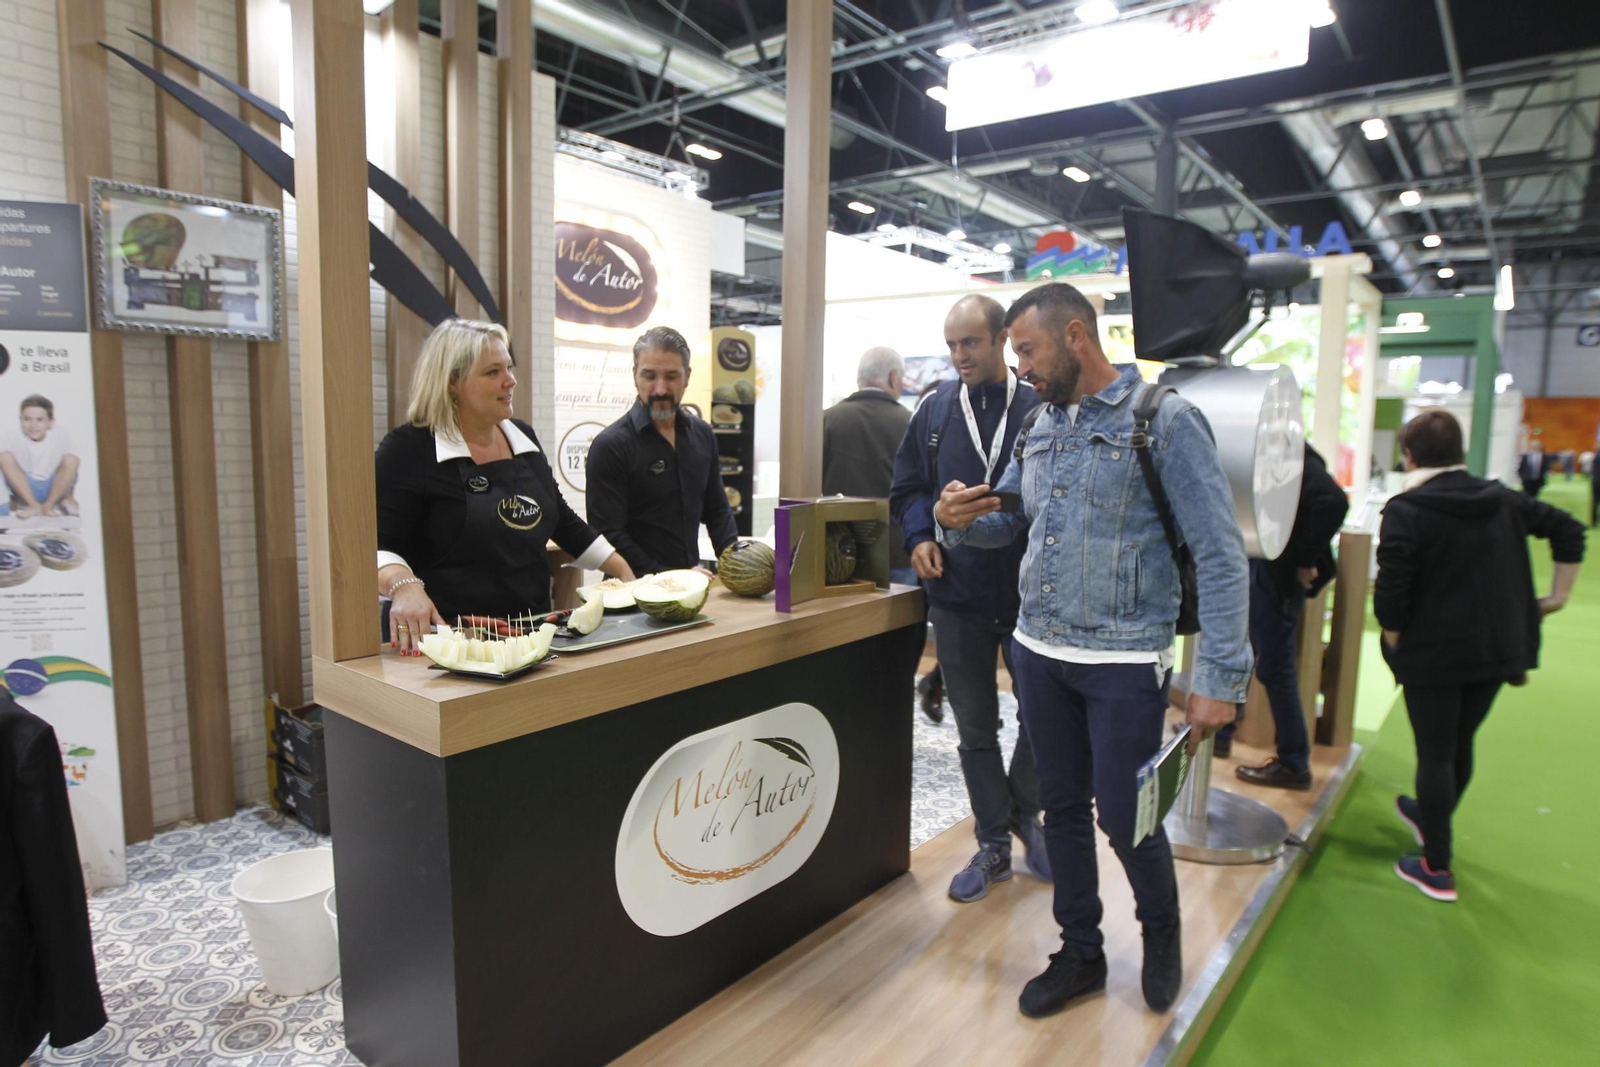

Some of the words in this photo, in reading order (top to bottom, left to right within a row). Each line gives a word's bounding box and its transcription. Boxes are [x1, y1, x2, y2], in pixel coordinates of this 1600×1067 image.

[572, 261, 591, 283] de
[589, 263, 643, 290] Autor
[20, 346, 34, 357] te
[37, 346, 69, 358] lleva
[20, 363, 29, 373] a
[33, 361, 71, 374] Brasil
[568, 455, 580, 470] 12
[519, 504, 541, 519] Autor
[660, 741, 755, 819] Melón
[701, 796, 727, 843] de
[730, 770, 815, 836] Autor
